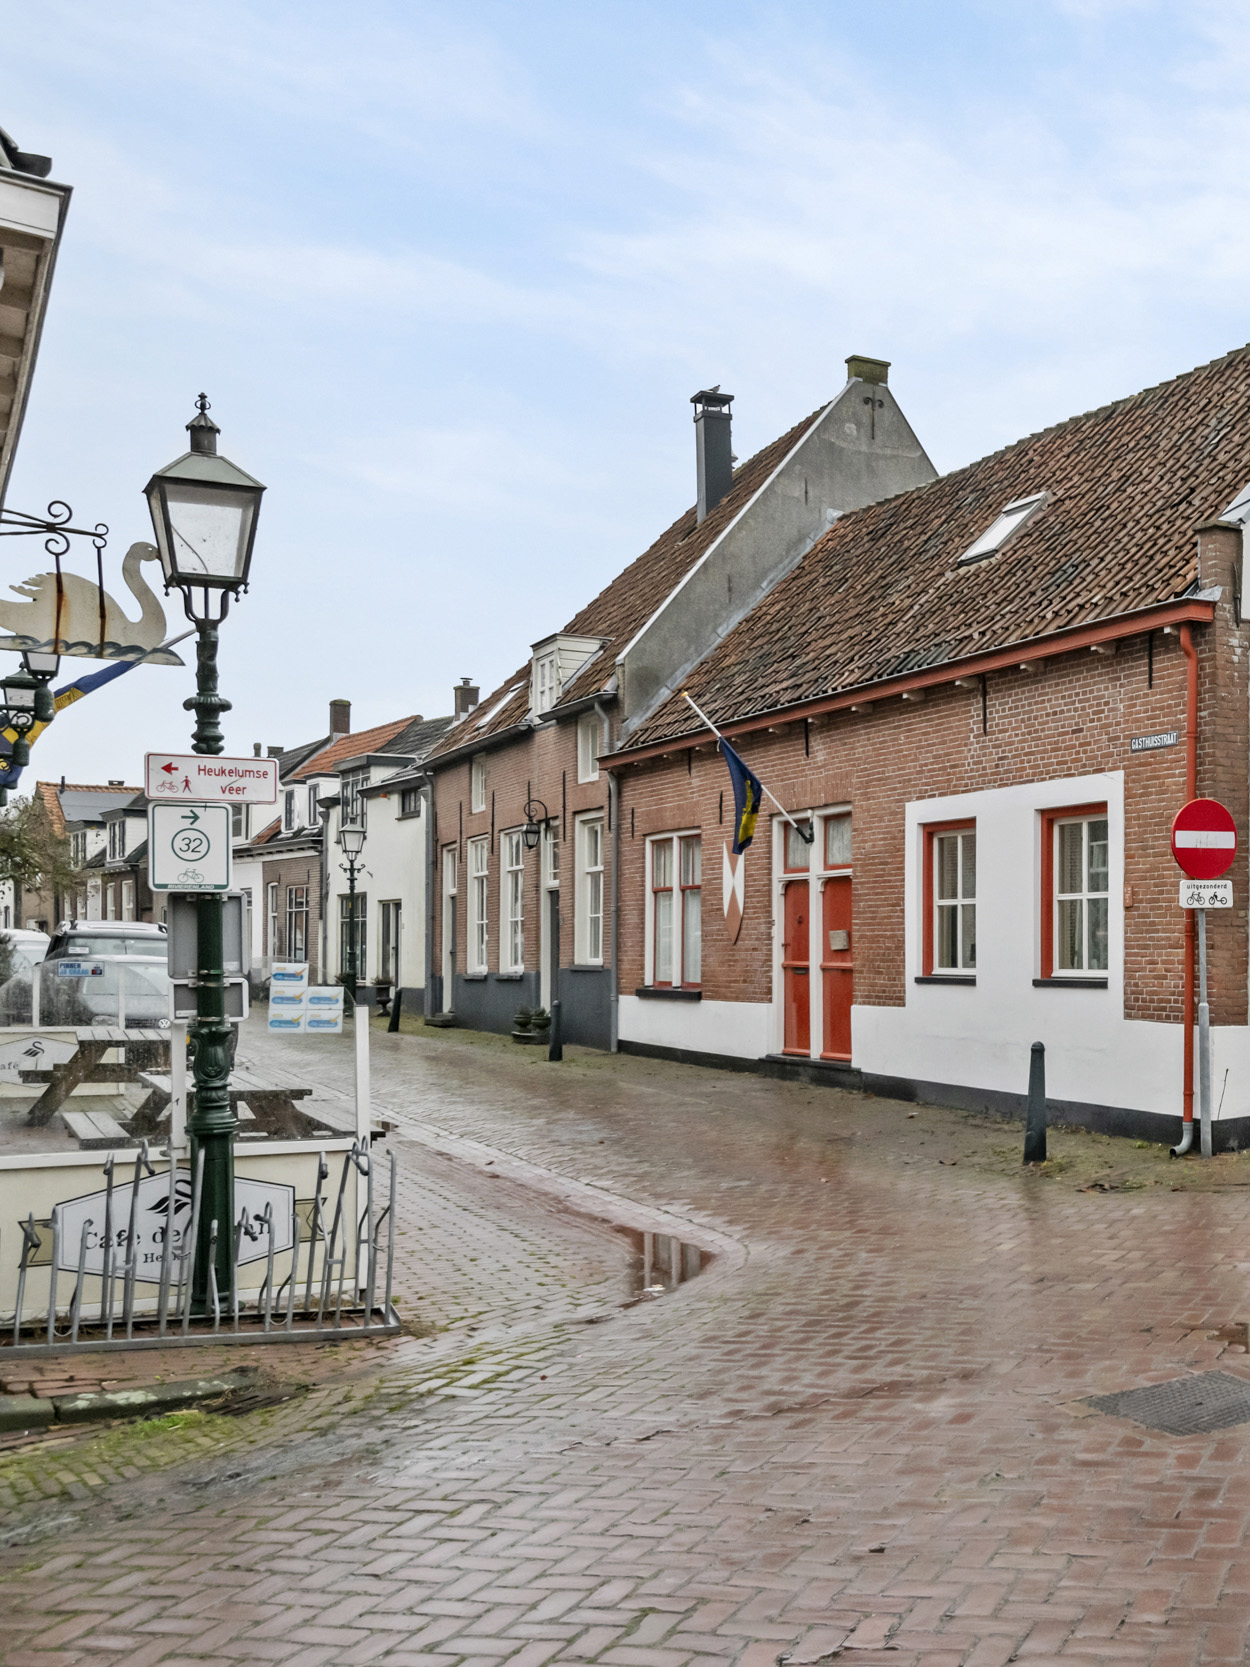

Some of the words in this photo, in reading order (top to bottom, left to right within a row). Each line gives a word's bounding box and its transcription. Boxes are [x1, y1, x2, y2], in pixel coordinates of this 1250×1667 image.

[1131, 732, 1177, 750] GASTHUISSTRAAT
[197, 765, 269, 779] Heukelumse
[220, 786, 247, 795] veer
[179, 837, 203, 853] 32
